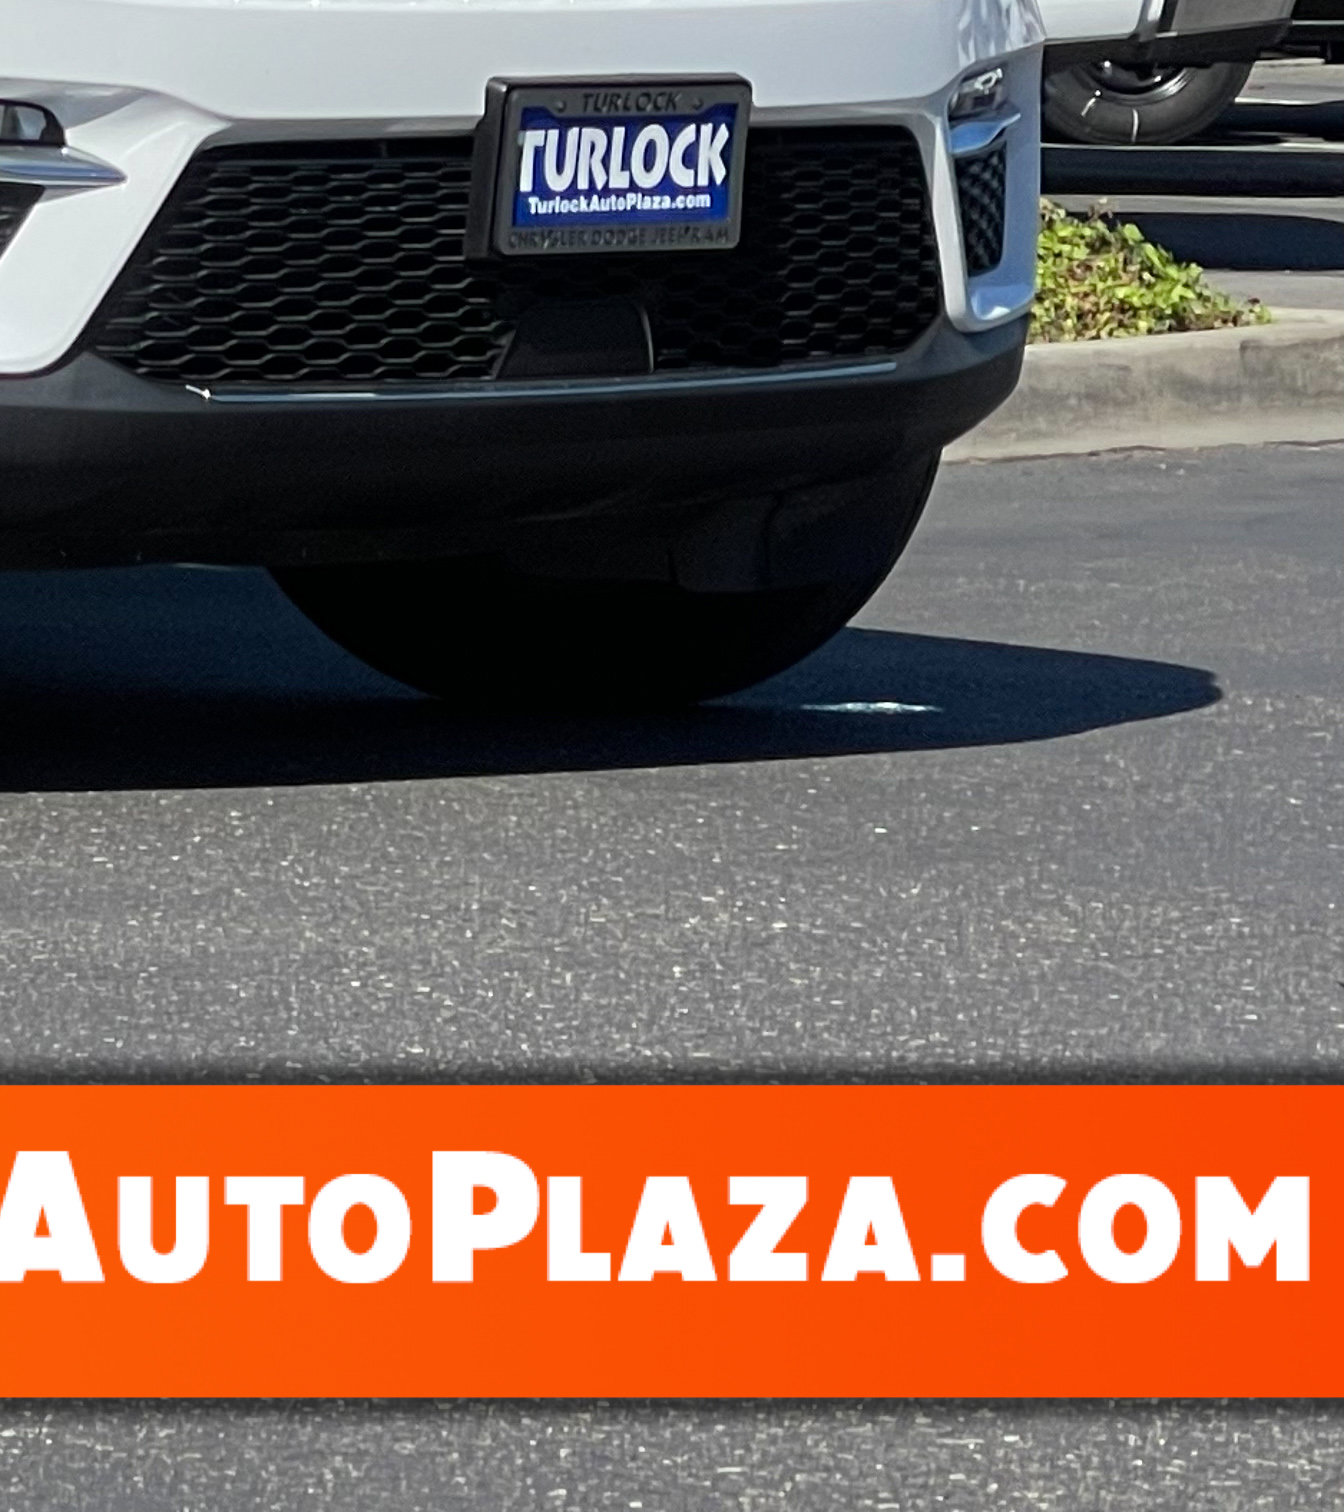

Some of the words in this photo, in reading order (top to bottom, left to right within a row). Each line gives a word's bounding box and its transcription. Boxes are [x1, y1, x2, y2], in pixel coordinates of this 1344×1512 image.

[581, 91, 681, 113] TURLOCK
[518, 122, 730, 193] TURLOCK
[528, 193, 712, 215] TurlockAutoPlaza.com
